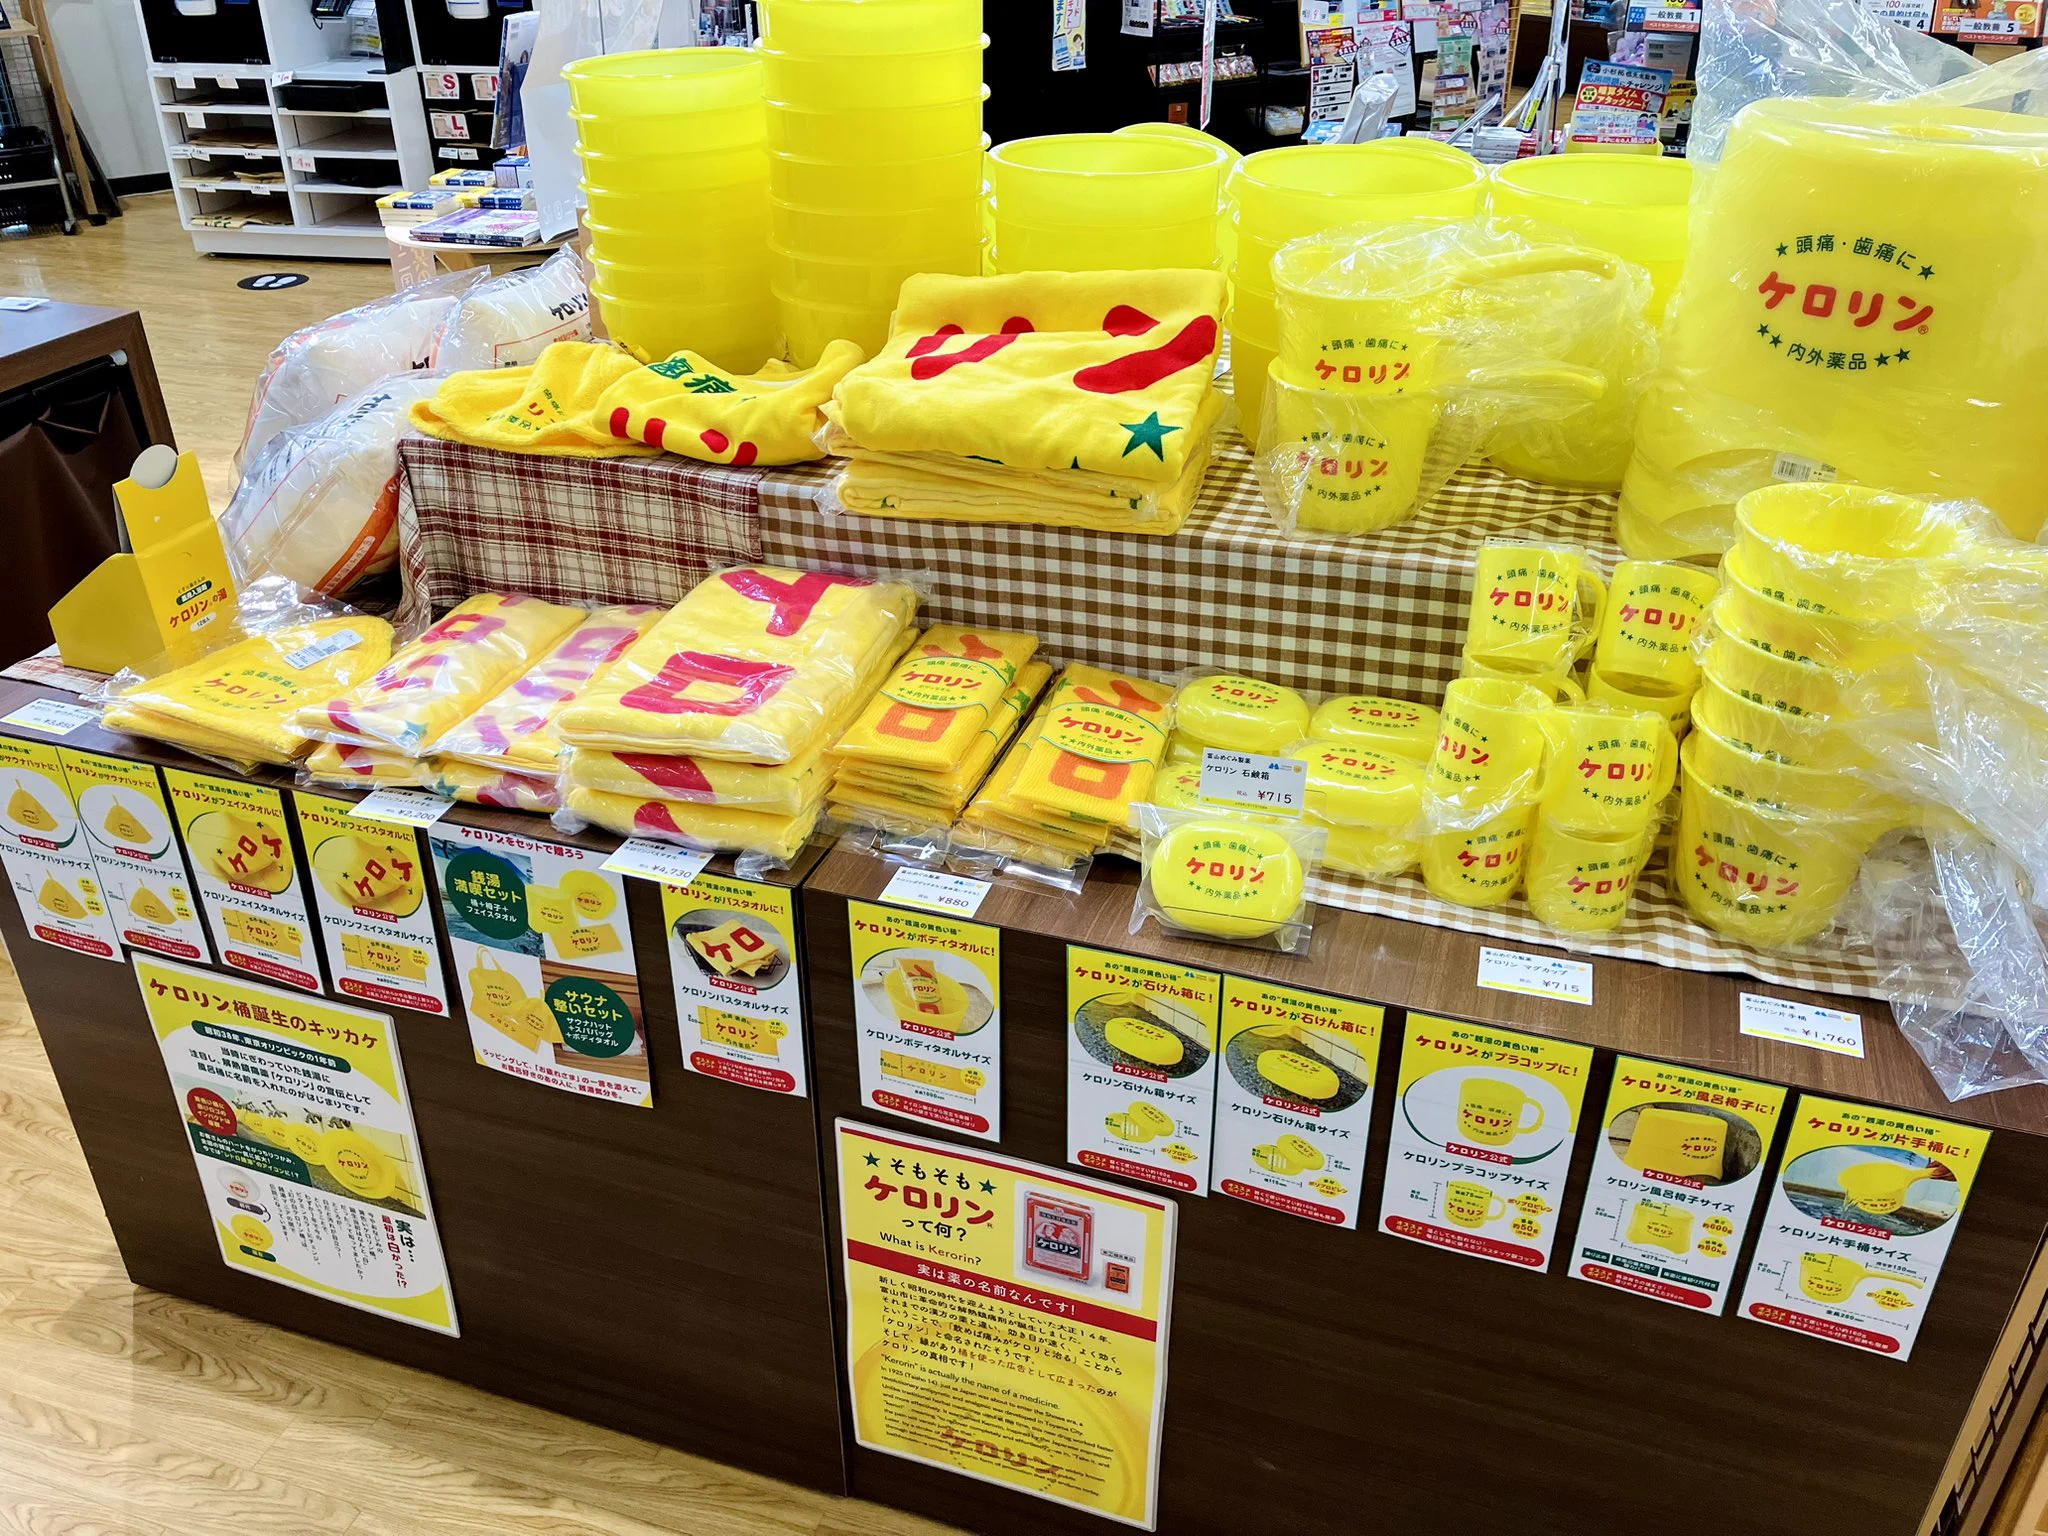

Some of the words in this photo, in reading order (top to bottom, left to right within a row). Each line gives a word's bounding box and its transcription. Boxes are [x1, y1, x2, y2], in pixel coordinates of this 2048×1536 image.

[1916, 20, 1925, 30] 4
[2006, 23, 2015, 33] 5
[443, 74, 456, 90] S
[451, 116, 464, 130] L
[1796, 234, 1917, 271] 頭痛・歯痛に
[1331, 338, 1401, 351] 頭痛・歯痛に
[1787, 343, 1868, 370] 内外薬品
[901, 671, 983, 688] ケロリン
[1212, 684, 1279, 704] ケロリン
[1347, 705, 1420, 723] ケロリン
[1058, 716, 1143, 743] ケロリン
[1206, 752, 1251, 765] 富山めぐみ製薬
[1321, 752, 1397, 775] ケロリン
[1206, 764, 1236, 775] ケロリン
[172, 787, 283, 817] ケロリンがフェイスタオルに!
[1257, 789, 1293, 804] ¥715
[397, 808, 436, 821] ¥2,200
[300, 810, 415, 842] ケロリンがフェイスタオルに!
[460, 827, 584, 860] ケロリンをセットで贈ろう
[1203, 841, 1256, 856] 頭痛・歯痛に
[470, 869, 501, 888] 銭湯
[651, 864, 692, 878] ¥4,730
[1186, 857, 1265, 883] ケロリン
[230, 883, 270, 897] ケロリン公式
[454, 878, 522, 904] 満喫セット
[667, 884, 785, 914] ケロリンがバスタオルに!
[1205, 888, 1241, 900] 内外薬品
[938, 895, 969, 907] ¥880
[355, 907, 396, 922] ケロリン公式
[466, 905, 517, 923] フェイスタオル
[854, 919, 996, 957] ケロリンがボディタオルに!
[1485, 958, 1518, 967] ケロリン
[711, 978, 756, 993] ケロリン公式
[1074, 966, 1214, 1003] ケロリンが石けん箱に!
[1543, 980, 1580, 993] ¥715
[565, 990, 608, 1004] サウナ
[553, 998, 624, 1021] 整いセット
[1230, 995, 1375, 1036] ケロリンが石けん箱に!
[1745, 1005, 1807, 1021] ケロリン片手桶
[566, 1016, 613, 1031] サウナハット
[903, 1022, 953, 1039] ケロリン公式
[1802, 1028, 1857, 1046] ¥1,760
[866, 1029, 992, 1065] ケロリンボディタオルサイズ
[1415, 1035, 1578, 1077] ケロリンがプラコップに!
[1114, 1064, 1165, 1082] ケロリン公式
[1082, 1072, 1198, 1105] ケロリン石けん箱サイズ
[1621, 1075, 1775, 1116] ケロリンが風呂椅子に!
[1264, 1096, 1319, 1116] ケロリン公式
[1231, 1102, 1351, 1139] ケロリン石けん箱サイズ
[1462, 1109, 1513, 1128] ケロリン
[1807, 1117, 1970, 1158] ケロリンが片手桶に!
[1448, 1145, 1509, 1164] ケロリン公式
[890, 1157, 971, 1190] そもそも
[1403, 1151, 1550, 1191] ケロリンプラコップサイズ
[1645, 1170, 1701, 1189] ケロリン公式
[1606, 1176, 1735, 1213] ケロリン風呂椅子サイズ
[901, 1218, 968, 1242] って何?
[1824, 1218, 1889, 1238] ケロリン公式
[880, 1231, 913, 1249] What
[916, 1242, 926, 1252] is
[928, 1244, 982, 1266] Kerorin?
[1779, 1225, 1912, 1262] ケロリン片手桶サイズ
[917, 1263, 1077, 1315] 実は薬の名前なんです!
[920, 1363, 927, 1372] is
[928, 1369, 961, 1383] actually
[961, 1376, 976, 1387] the
[976, 1381, 1000, 1393] name
[1001, 1387, 1011, 1396] of
[1019, 1393, 1061, 1410] medicine.
